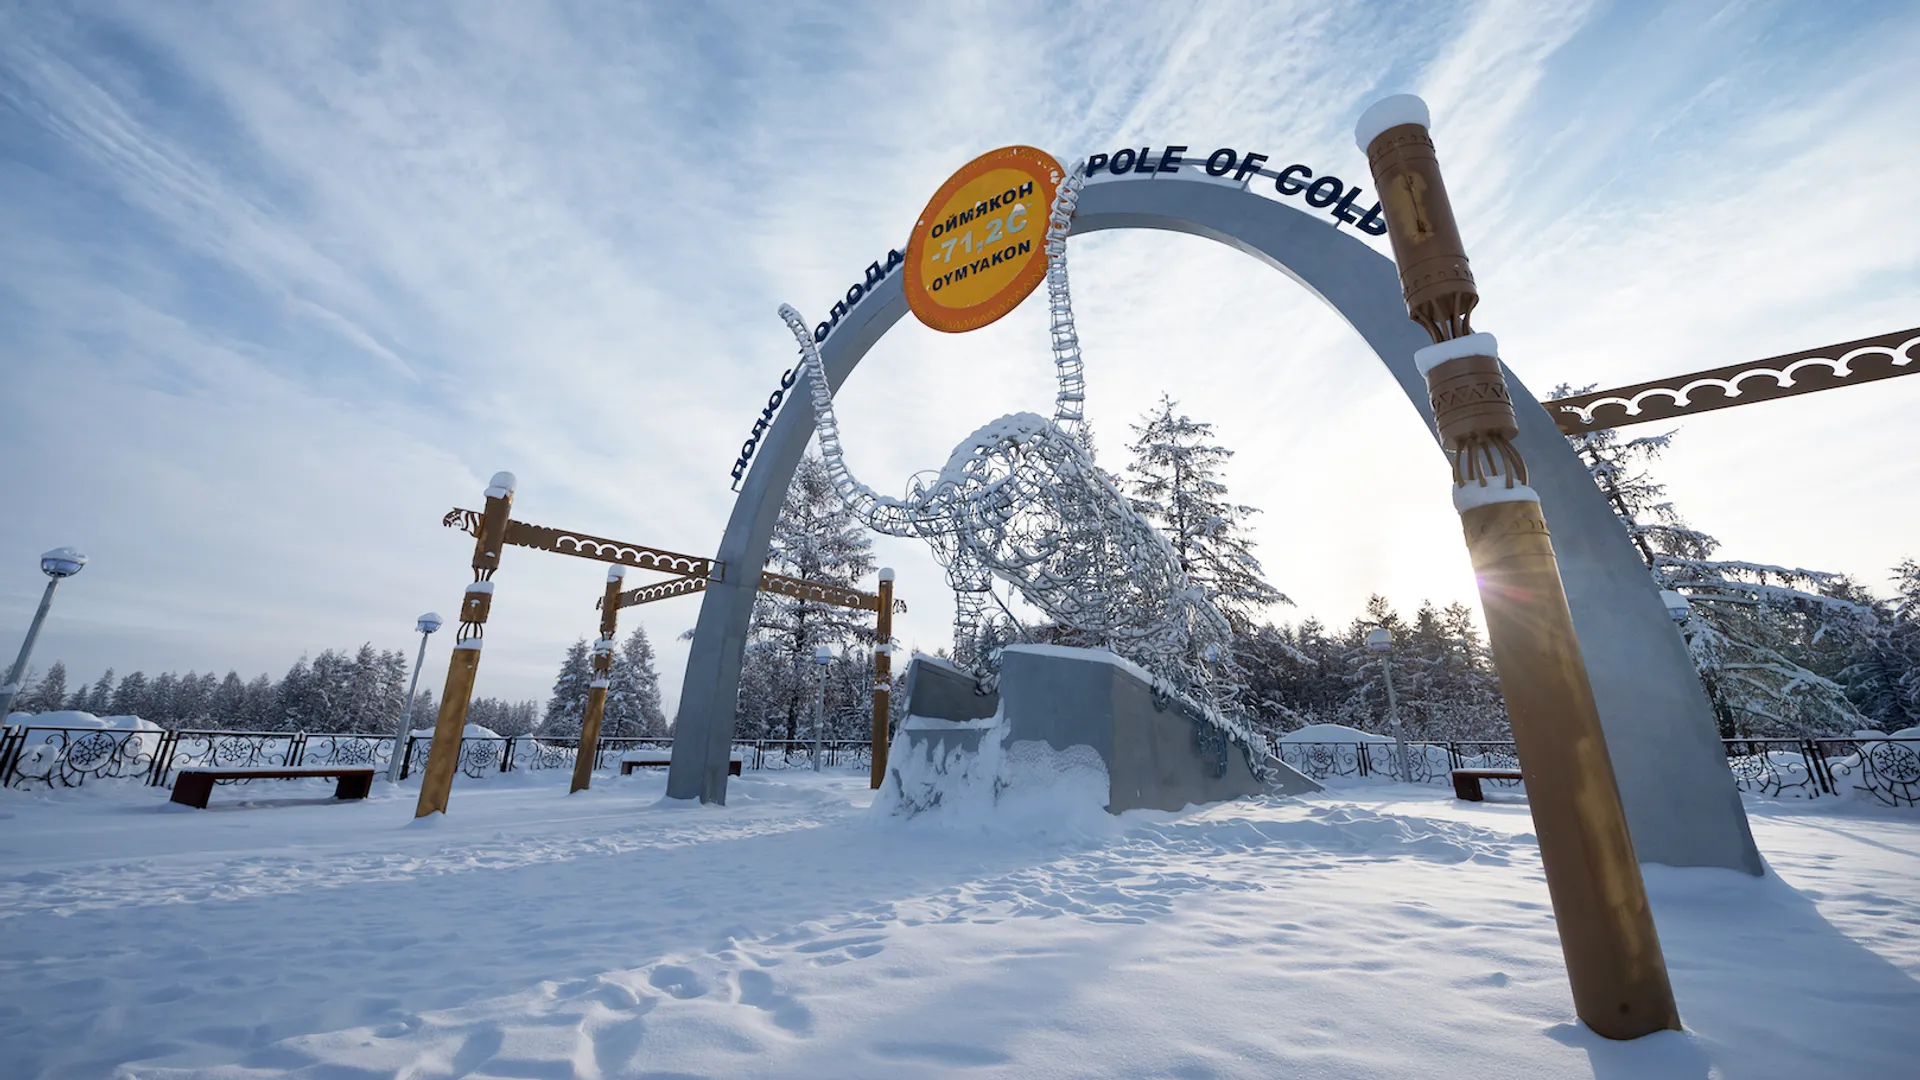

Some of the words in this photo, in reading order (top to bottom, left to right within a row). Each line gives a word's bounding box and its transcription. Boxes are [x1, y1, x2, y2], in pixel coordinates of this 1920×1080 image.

[1086, 145, 1188, 177] POLE
[1205, 148, 1268, 181] OF
[931, 181, 1033, 238] ОЙМЯКОН
[932, 239, 1031, 291] OYMYAKON
[731, 369, 796, 480] ПОЛЮС
[799, 249, 906, 353] ОЛОДА
